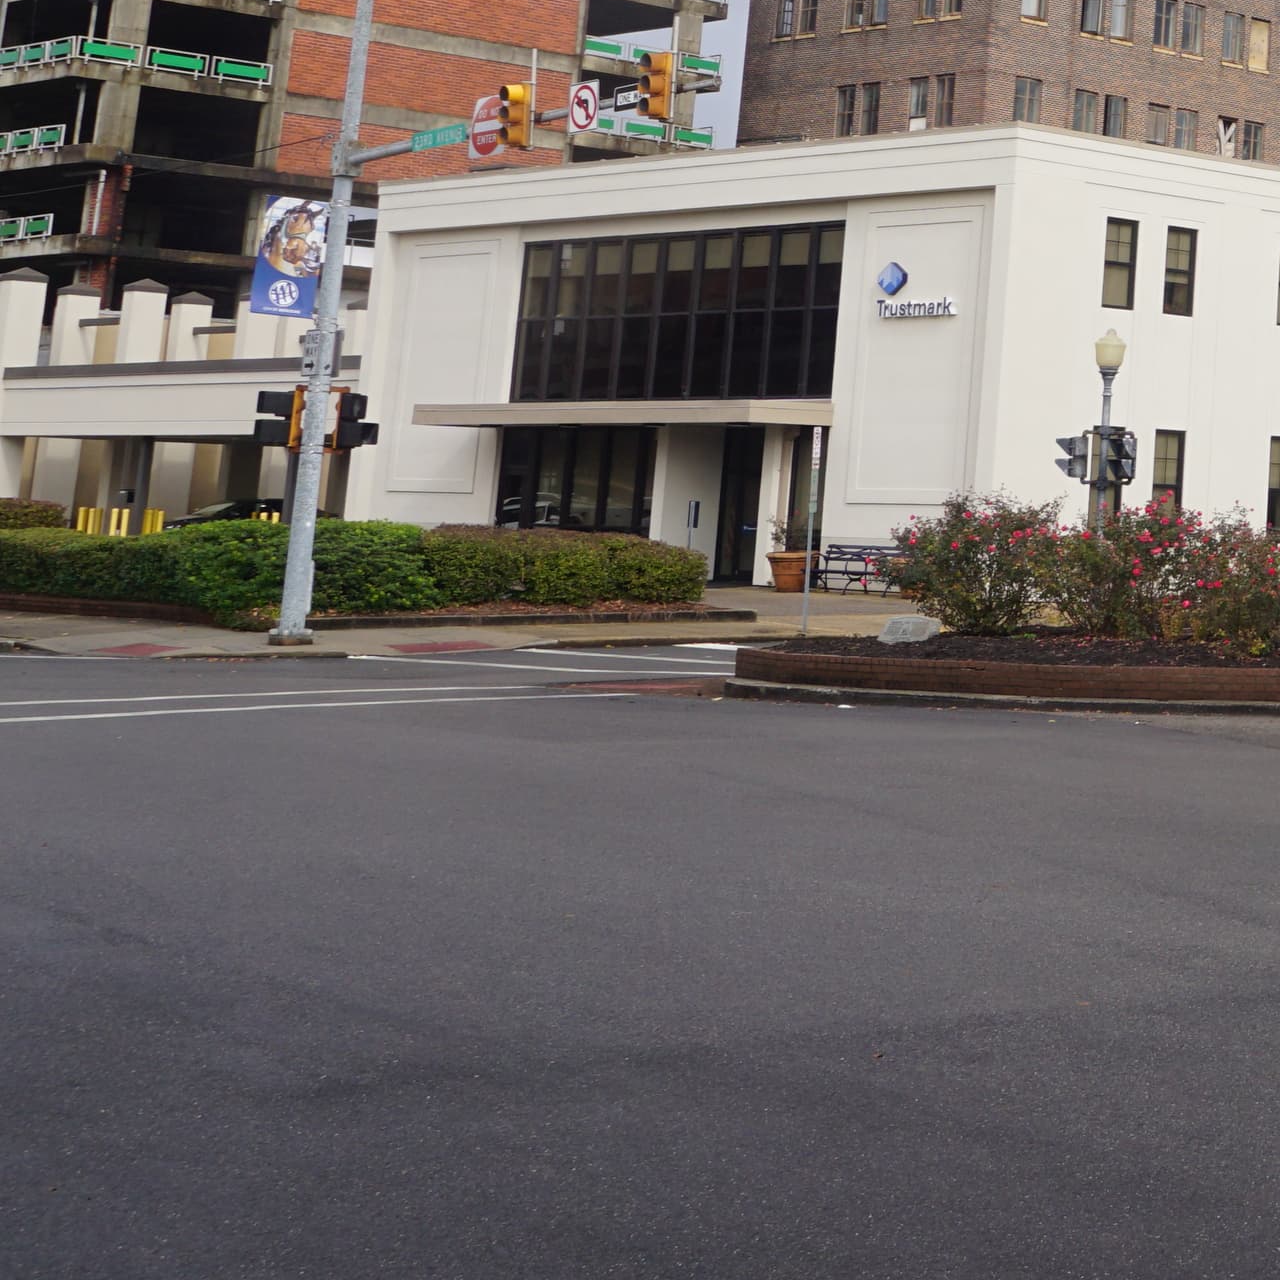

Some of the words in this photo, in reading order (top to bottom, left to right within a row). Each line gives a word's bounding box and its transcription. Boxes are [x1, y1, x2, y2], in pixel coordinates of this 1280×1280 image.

[619, 93, 632, 105] ONE
[478, 108, 488, 119] DO
[414, 133, 433, 148] 23RD
[476, 133, 497, 145] ENTER
[876, 296, 952, 317] Trustmark
[305, 333, 320, 345] ONE
